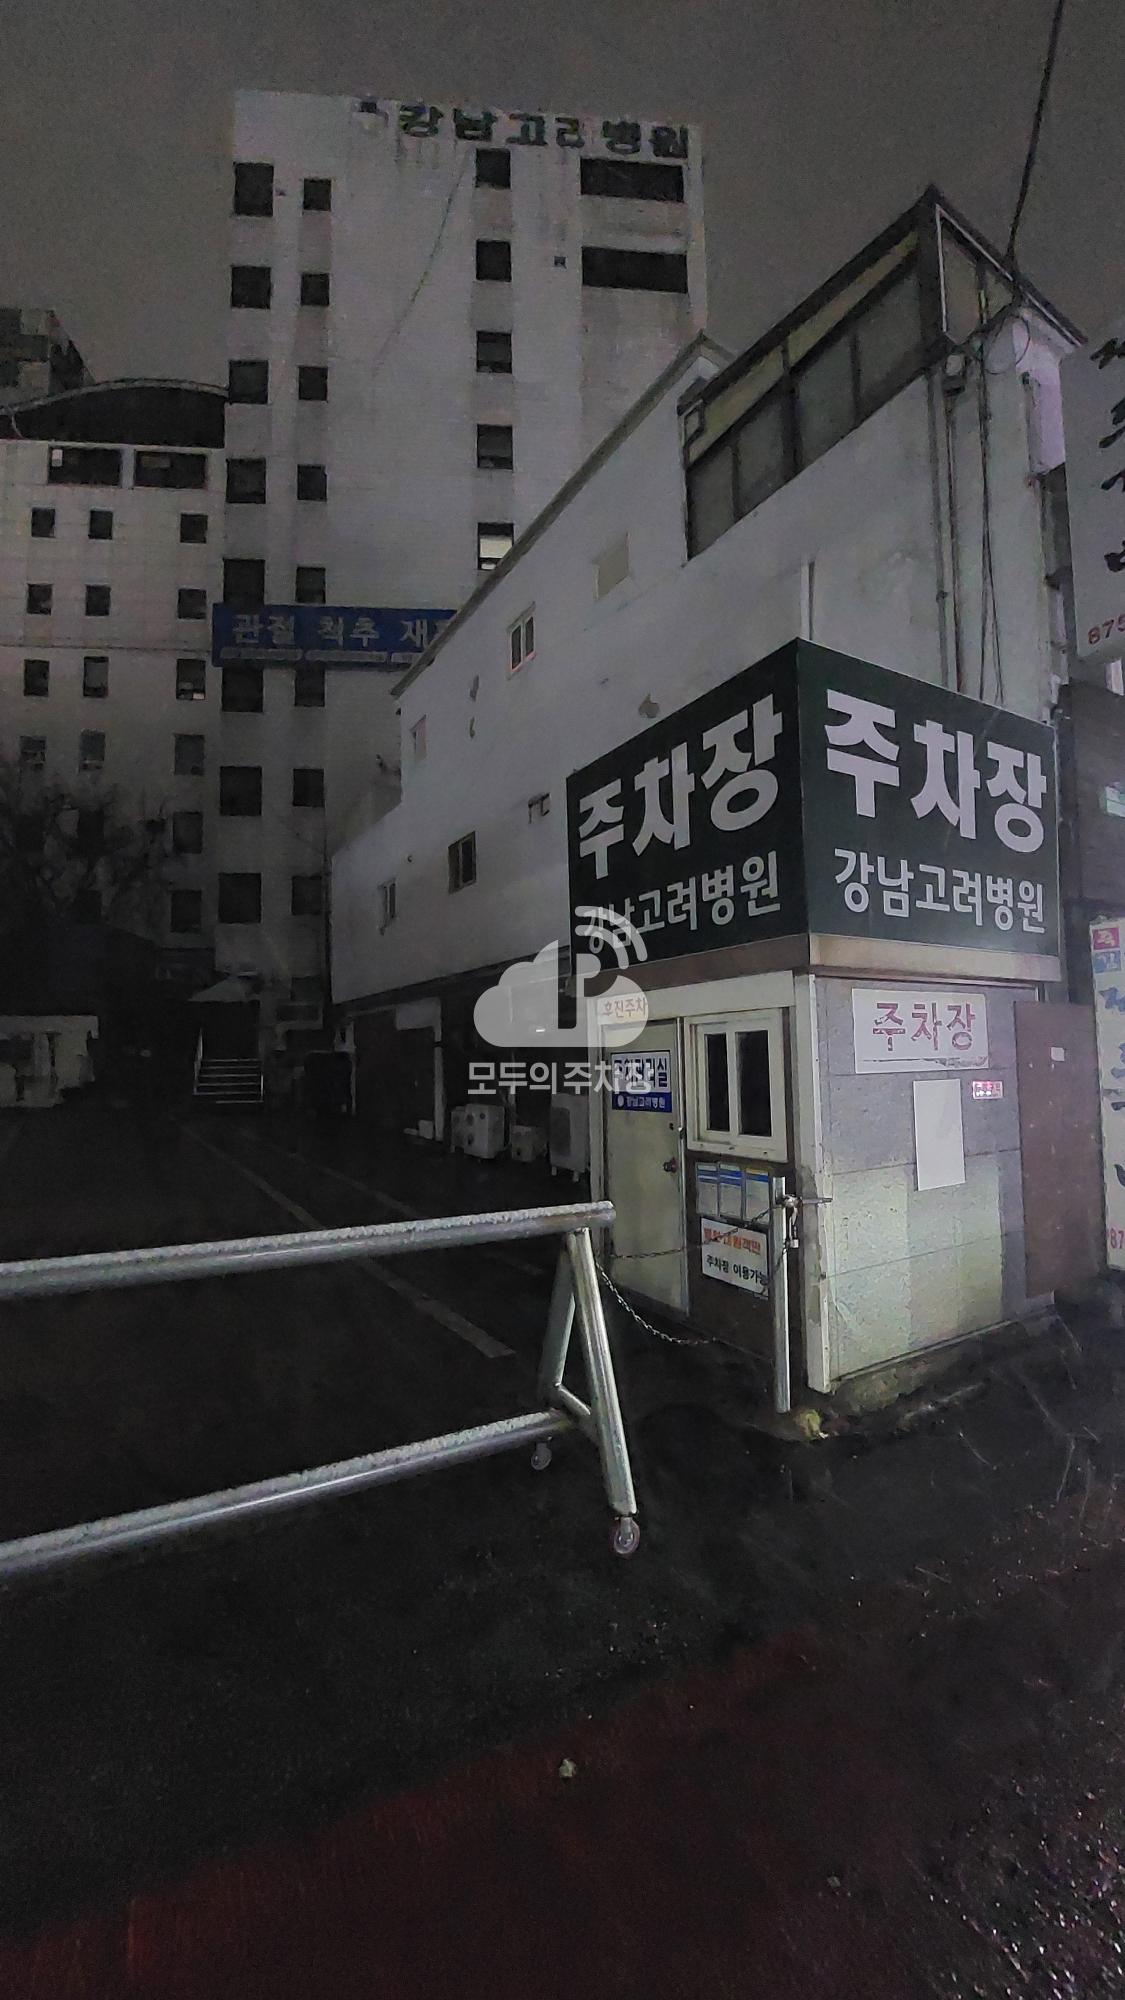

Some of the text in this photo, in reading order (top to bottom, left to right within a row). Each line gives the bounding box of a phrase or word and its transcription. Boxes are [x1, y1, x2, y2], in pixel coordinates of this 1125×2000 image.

[316, 614, 381, 648] 척추
[577, 692, 785, 881] 주차장
[823, 687, 1048, 854] 주차장
[584, 848, 782, 955] 강남고려병원
[833, 846, 1047, 937] 강남고려병원
[872, 1001, 977, 1052] 주차장
